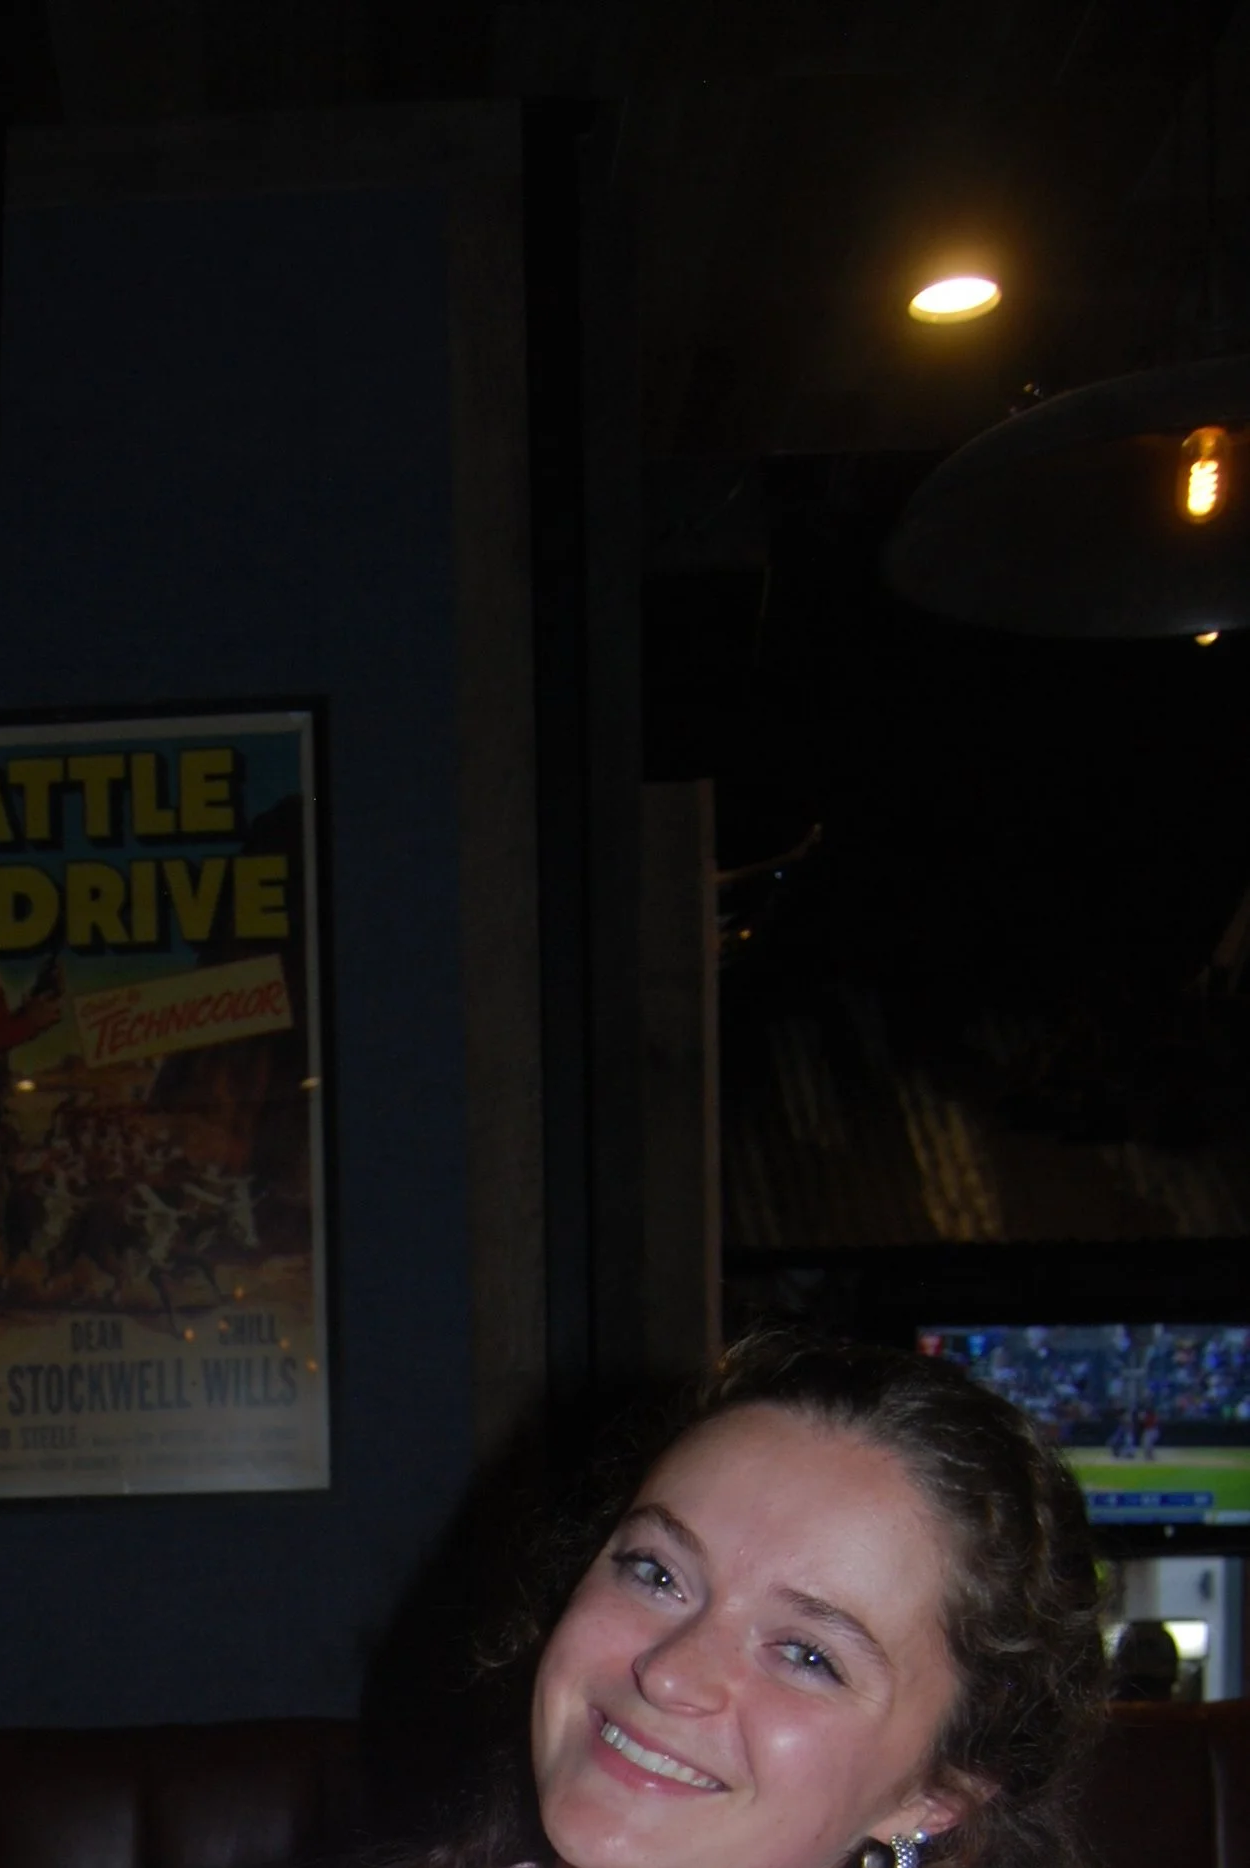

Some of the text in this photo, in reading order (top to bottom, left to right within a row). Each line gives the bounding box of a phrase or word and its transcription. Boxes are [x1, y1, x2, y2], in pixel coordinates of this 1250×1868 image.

[87, 979, 284, 1060] TECHNICOLOR
[70, 1318, 123, 1353] DEAN
[7, 1356, 192, 1418] STOCKWELL
[201, 1354, 298, 1410] WILLS
